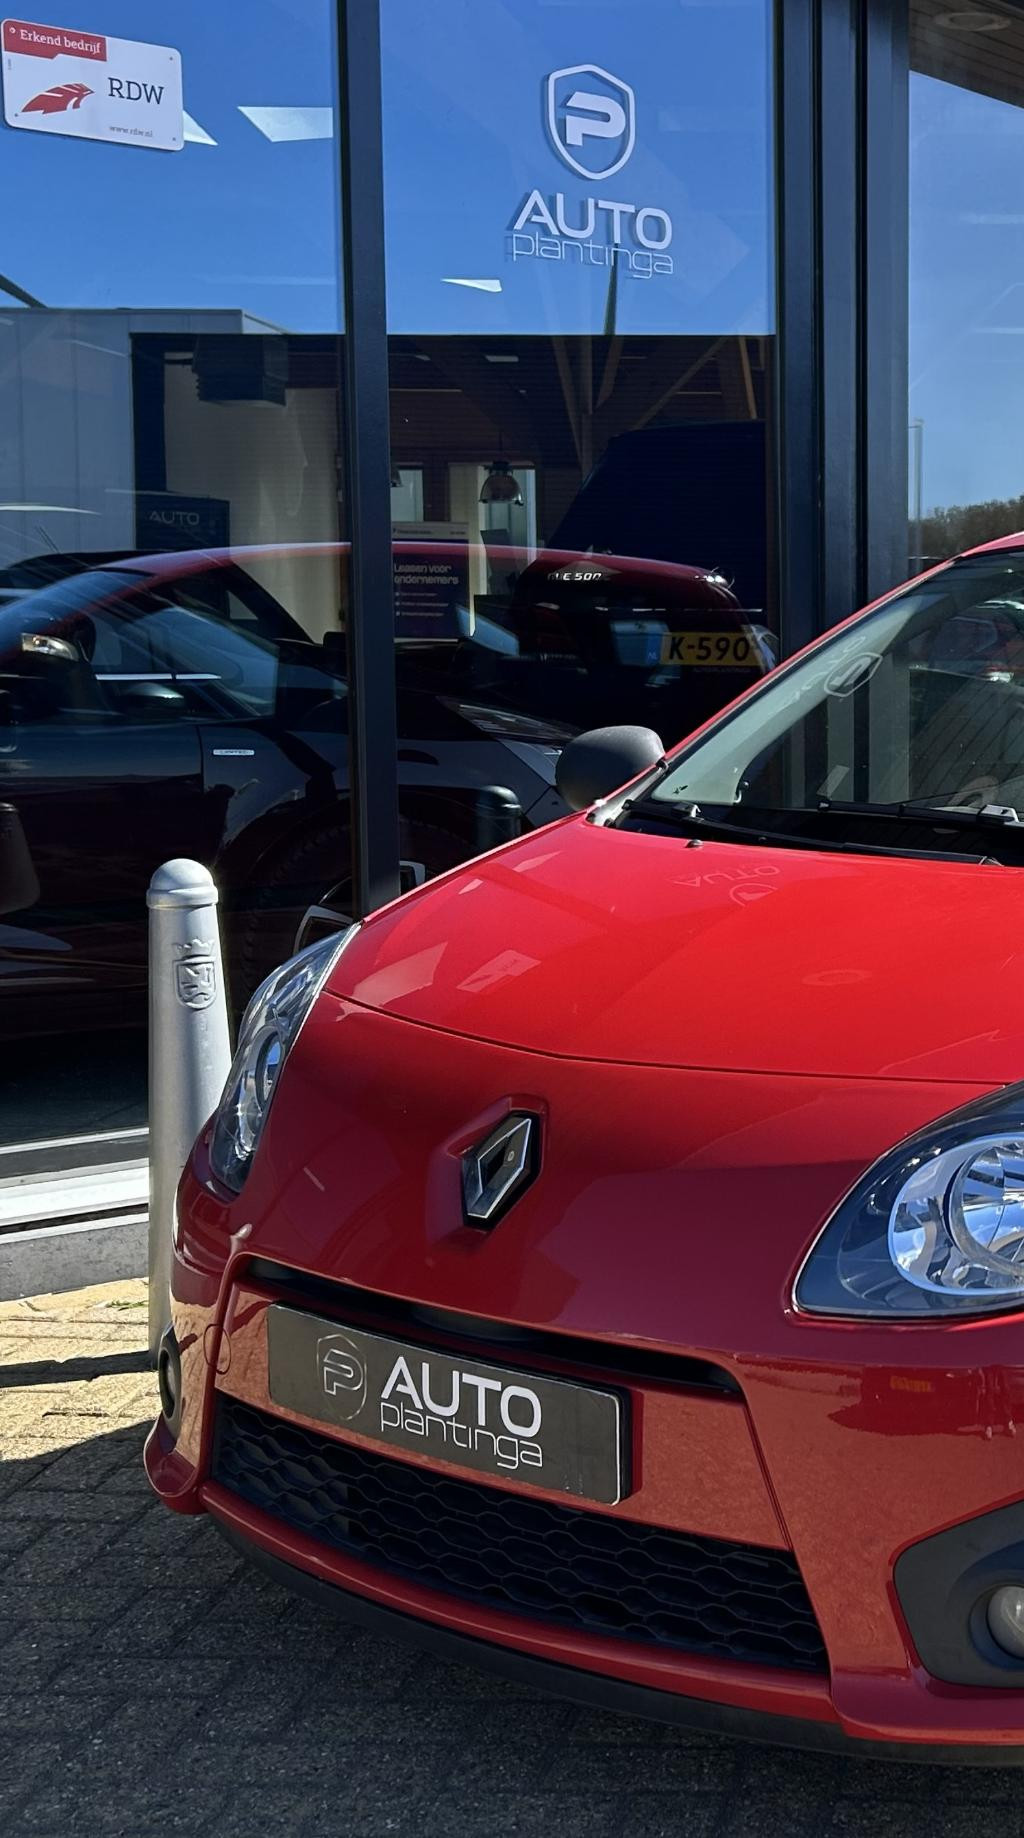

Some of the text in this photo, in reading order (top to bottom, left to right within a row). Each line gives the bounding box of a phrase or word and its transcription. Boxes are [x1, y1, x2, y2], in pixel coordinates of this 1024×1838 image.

[20, 29, 101, 55] Erkend bedrijf
[108, 77, 164, 105] RDW
[513, 189, 673, 250] AUTO
[512, 231, 674, 279] plantinga
[149, 510, 201, 526] AUTO
[381, 1356, 542, 1438] AUTO
[381, 1402, 543, 1470] plantinga
